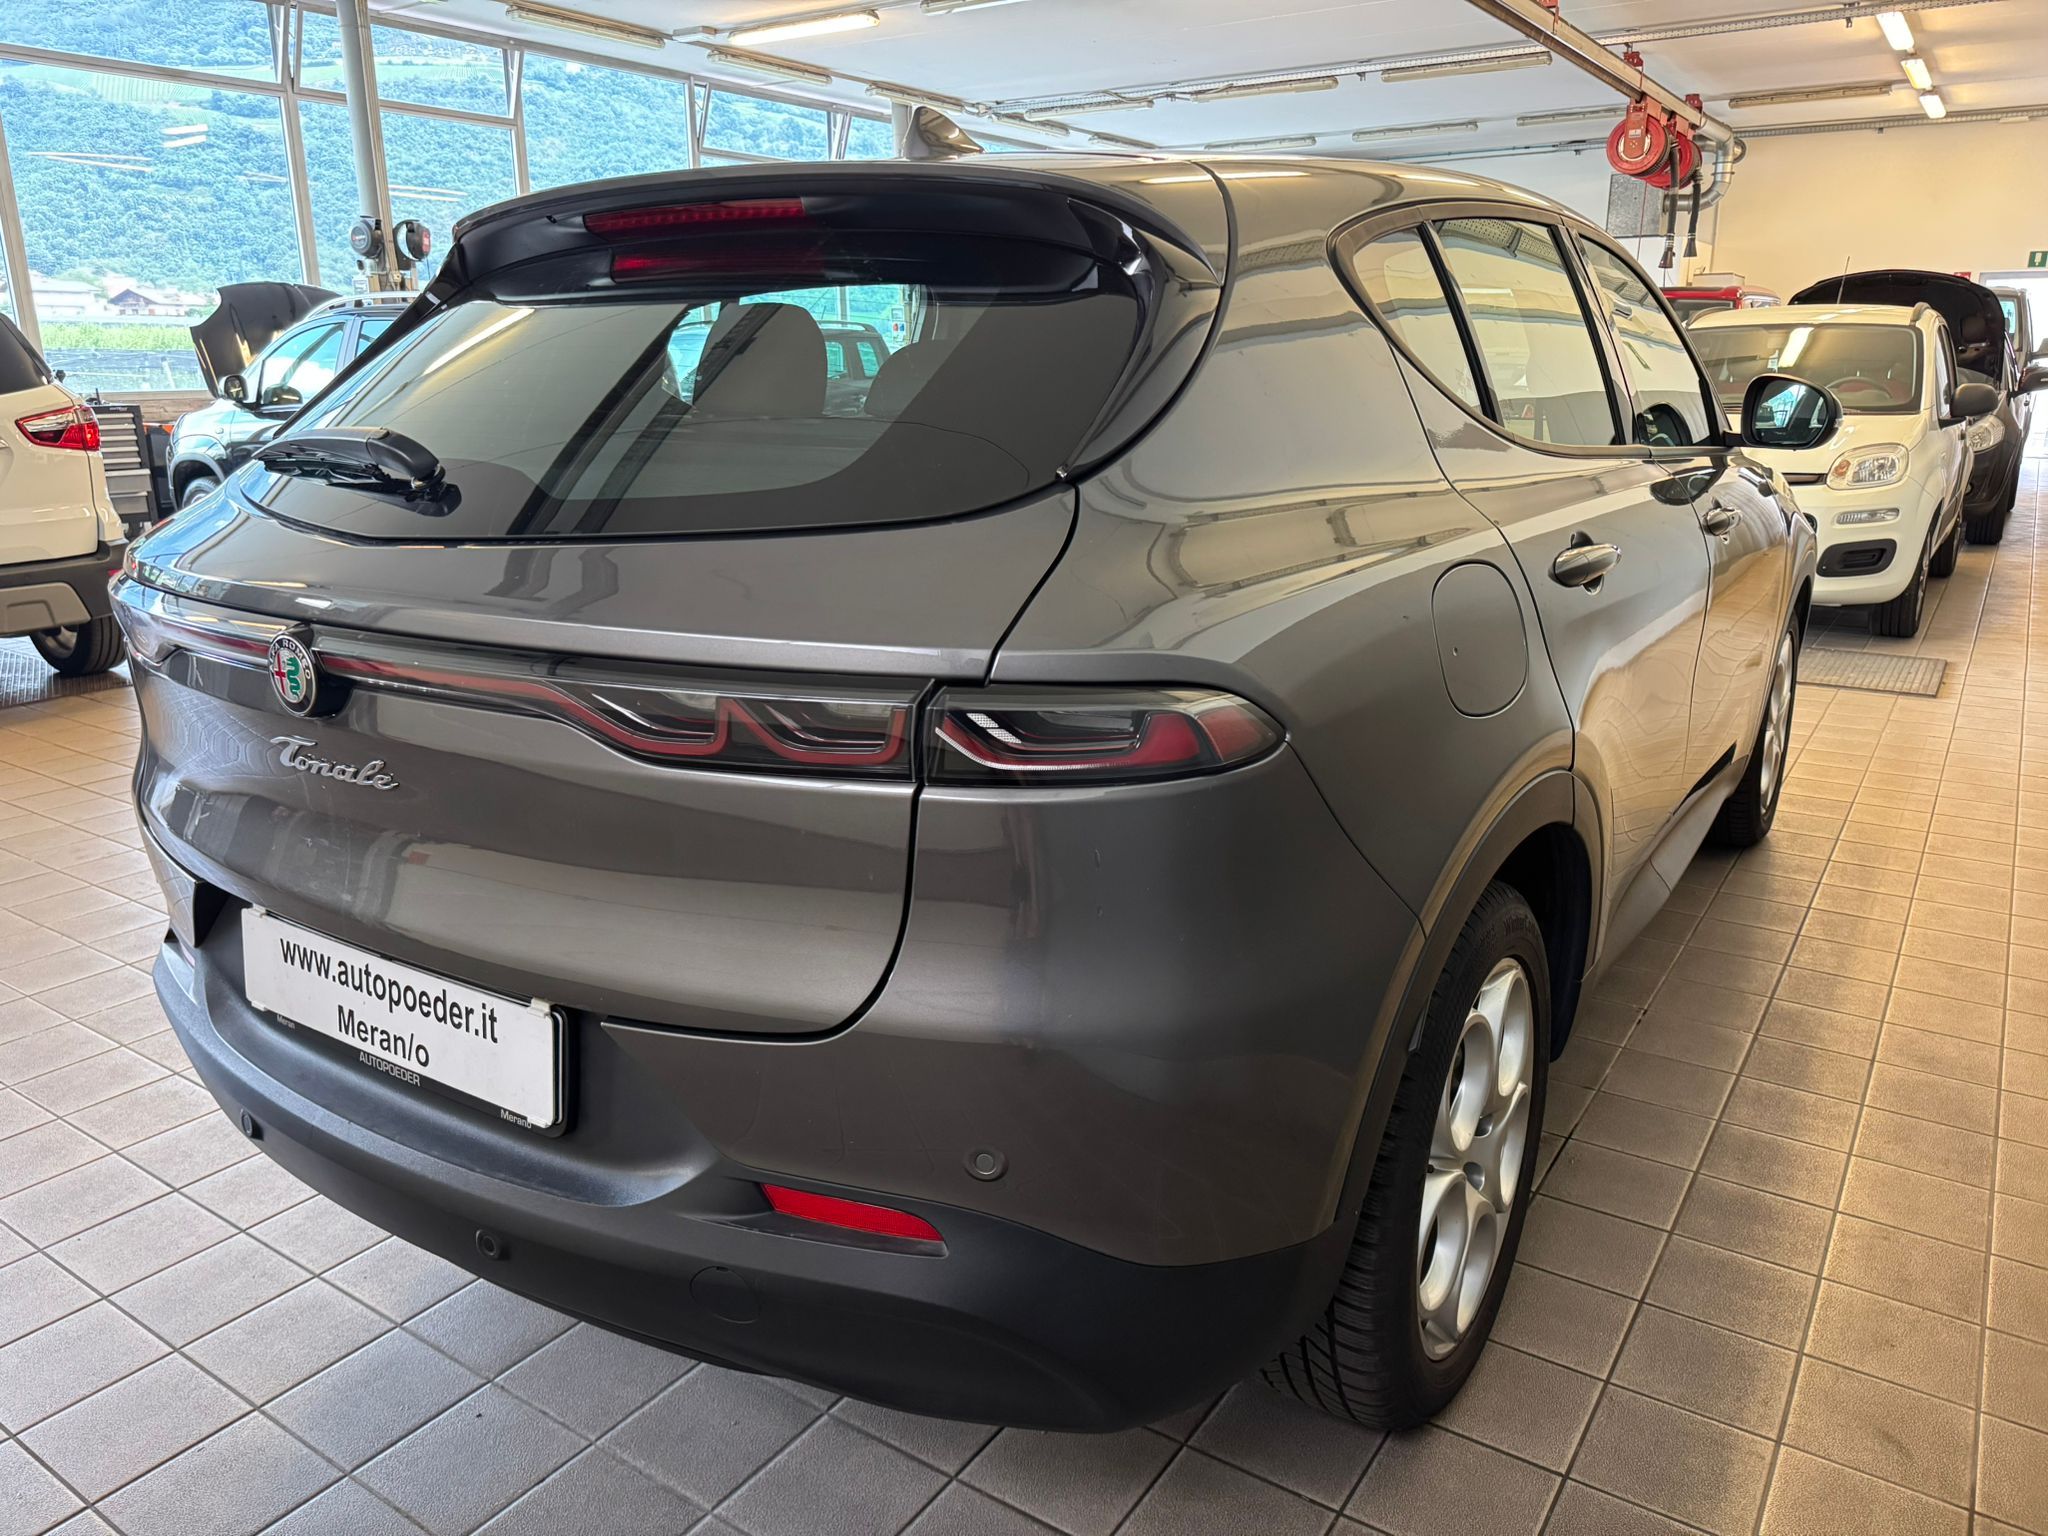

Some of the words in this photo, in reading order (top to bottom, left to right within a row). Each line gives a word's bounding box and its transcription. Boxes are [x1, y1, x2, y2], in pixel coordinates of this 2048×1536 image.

[282, 639, 311, 679] ROMEO
[270, 735, 399, 789] Tonale
[280, 938, 498, 1044] www.autopoeder.it
[276, 1014, 296, 1029] Meran
[338, 1005, 430, 1067] Meran/o
[359, 1051, 421, 1087] AUTOPOEDER
